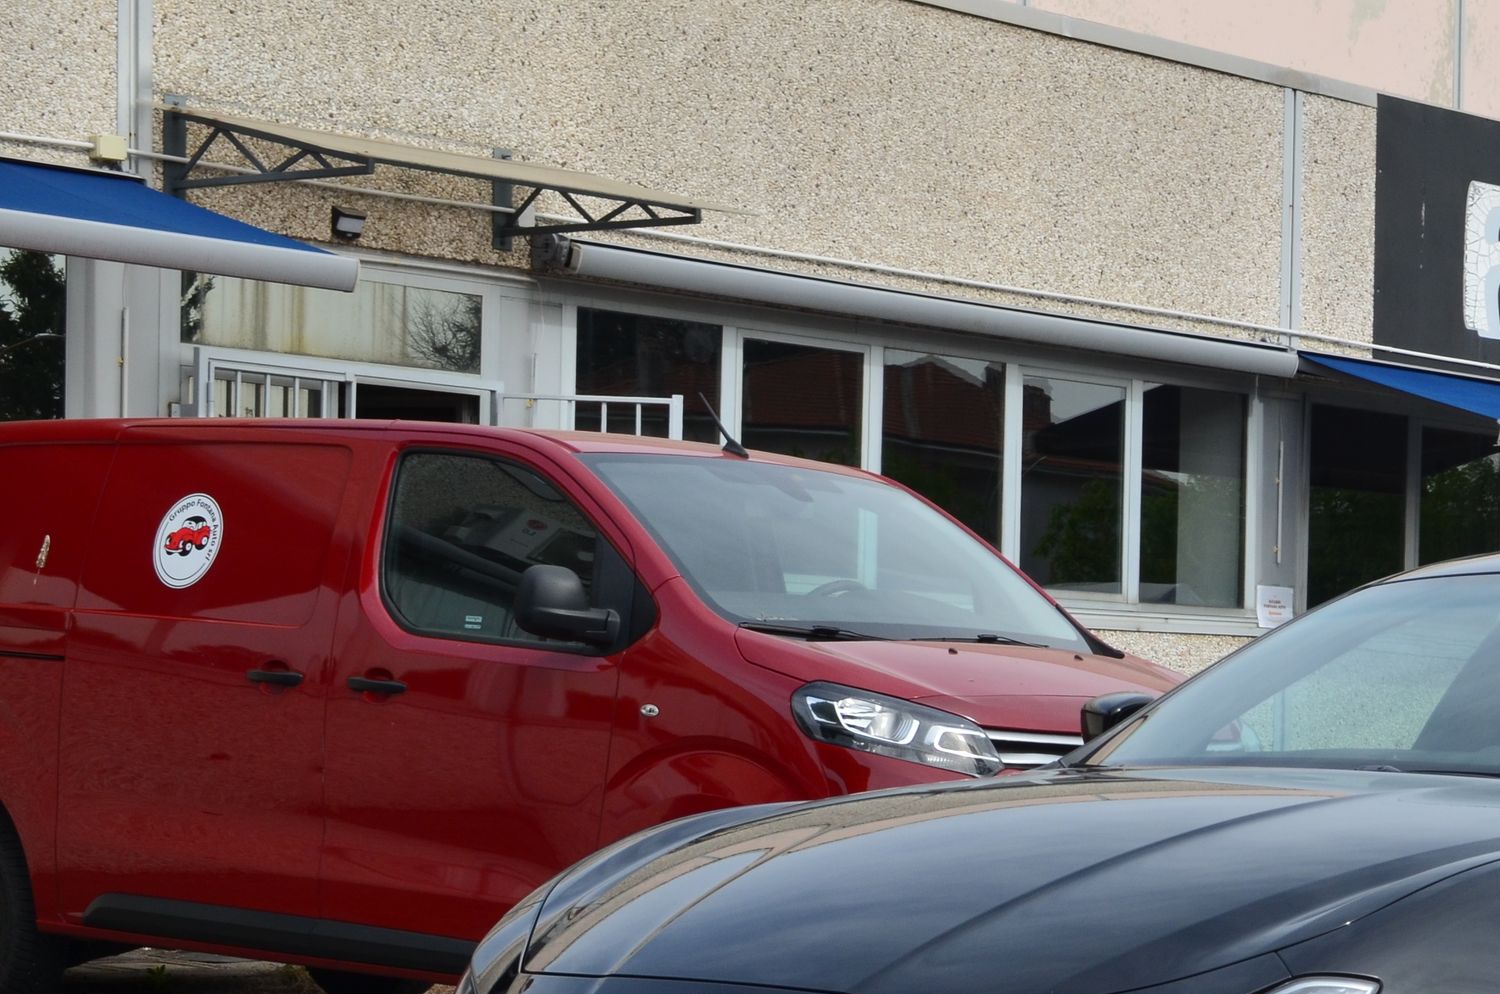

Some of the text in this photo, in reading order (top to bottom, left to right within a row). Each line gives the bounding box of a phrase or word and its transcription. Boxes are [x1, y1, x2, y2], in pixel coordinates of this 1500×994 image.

[169, 500, 195, 522] Gruppo
[197, 499, 216, 522] Fontana
[211, 524, 219, 547] Auto
